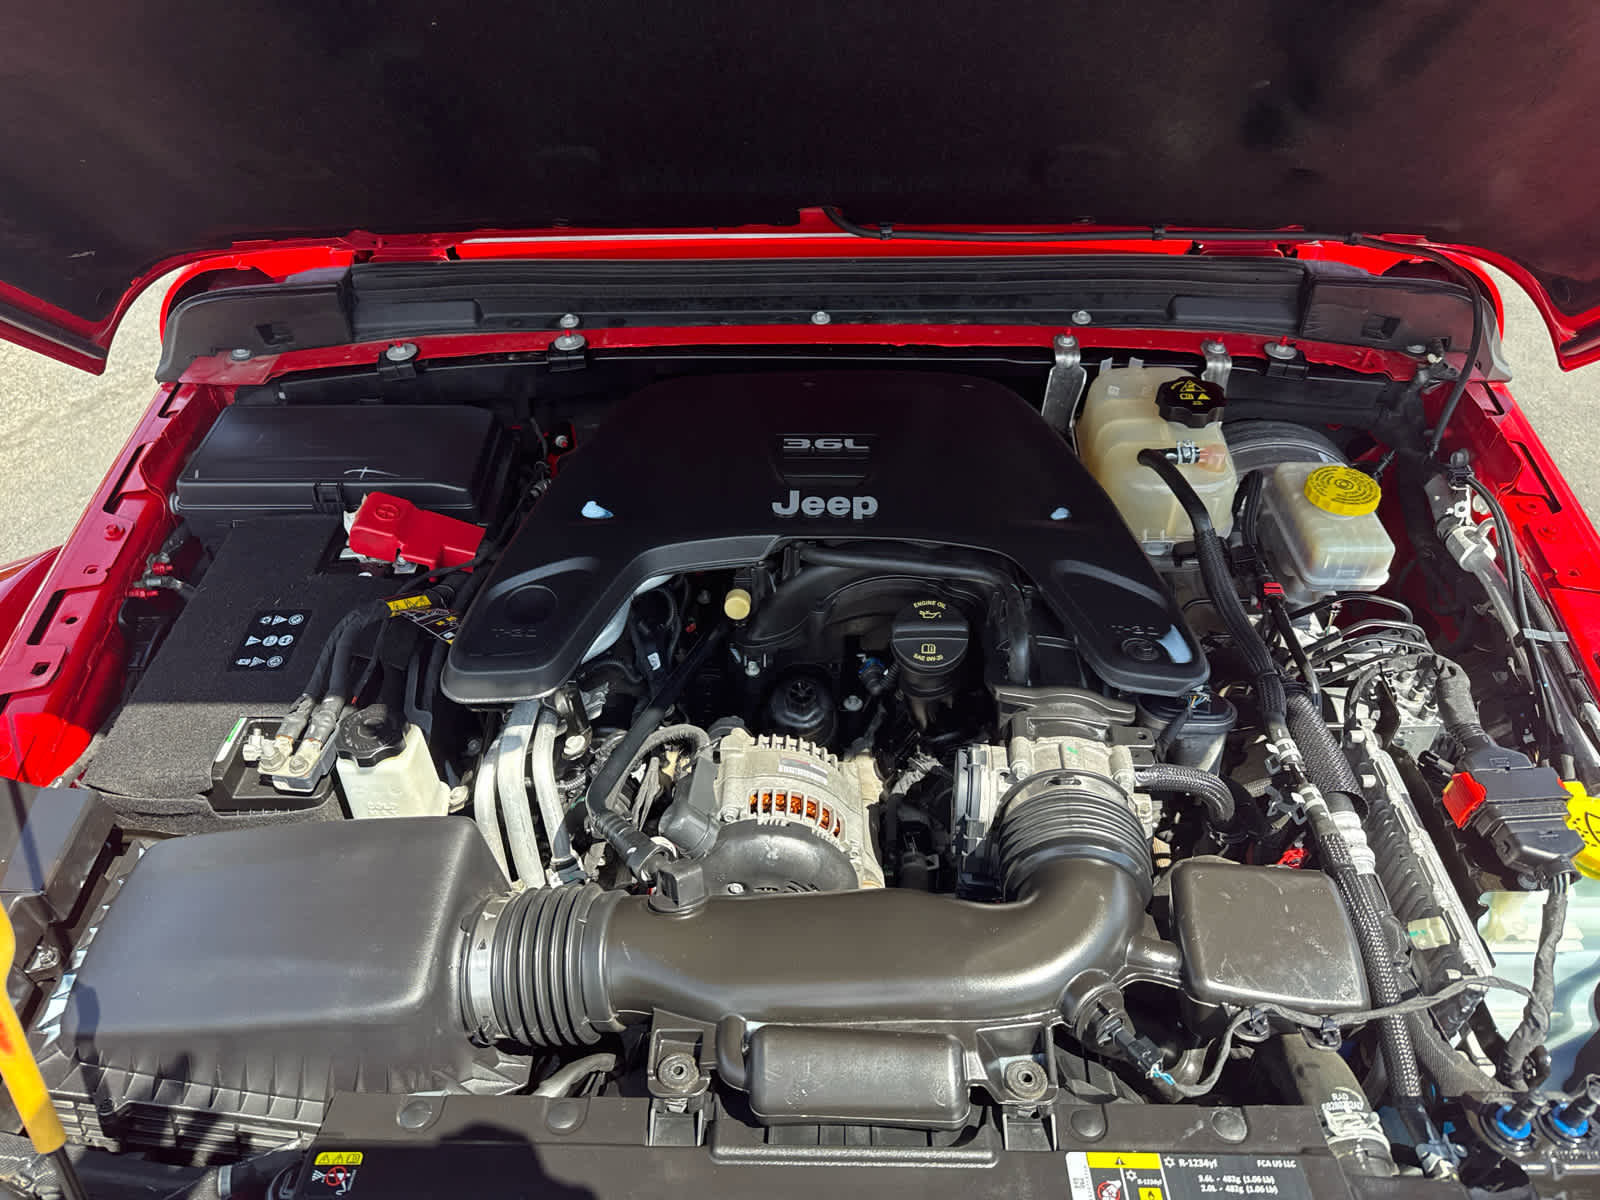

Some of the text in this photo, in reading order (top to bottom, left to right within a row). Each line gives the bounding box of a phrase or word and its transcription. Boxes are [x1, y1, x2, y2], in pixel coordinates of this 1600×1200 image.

[782, 438, 869, 450] 3.6L
[771, 490, 879, 519] Jeep
[913, 600, 946, 610] ENGINE OIL
[913, 653, 925, 661] SAE
[1178, 1158, 1218, 1169] R-1234yf
[1256, 1159, 1297, 1168] FCA US LLC
